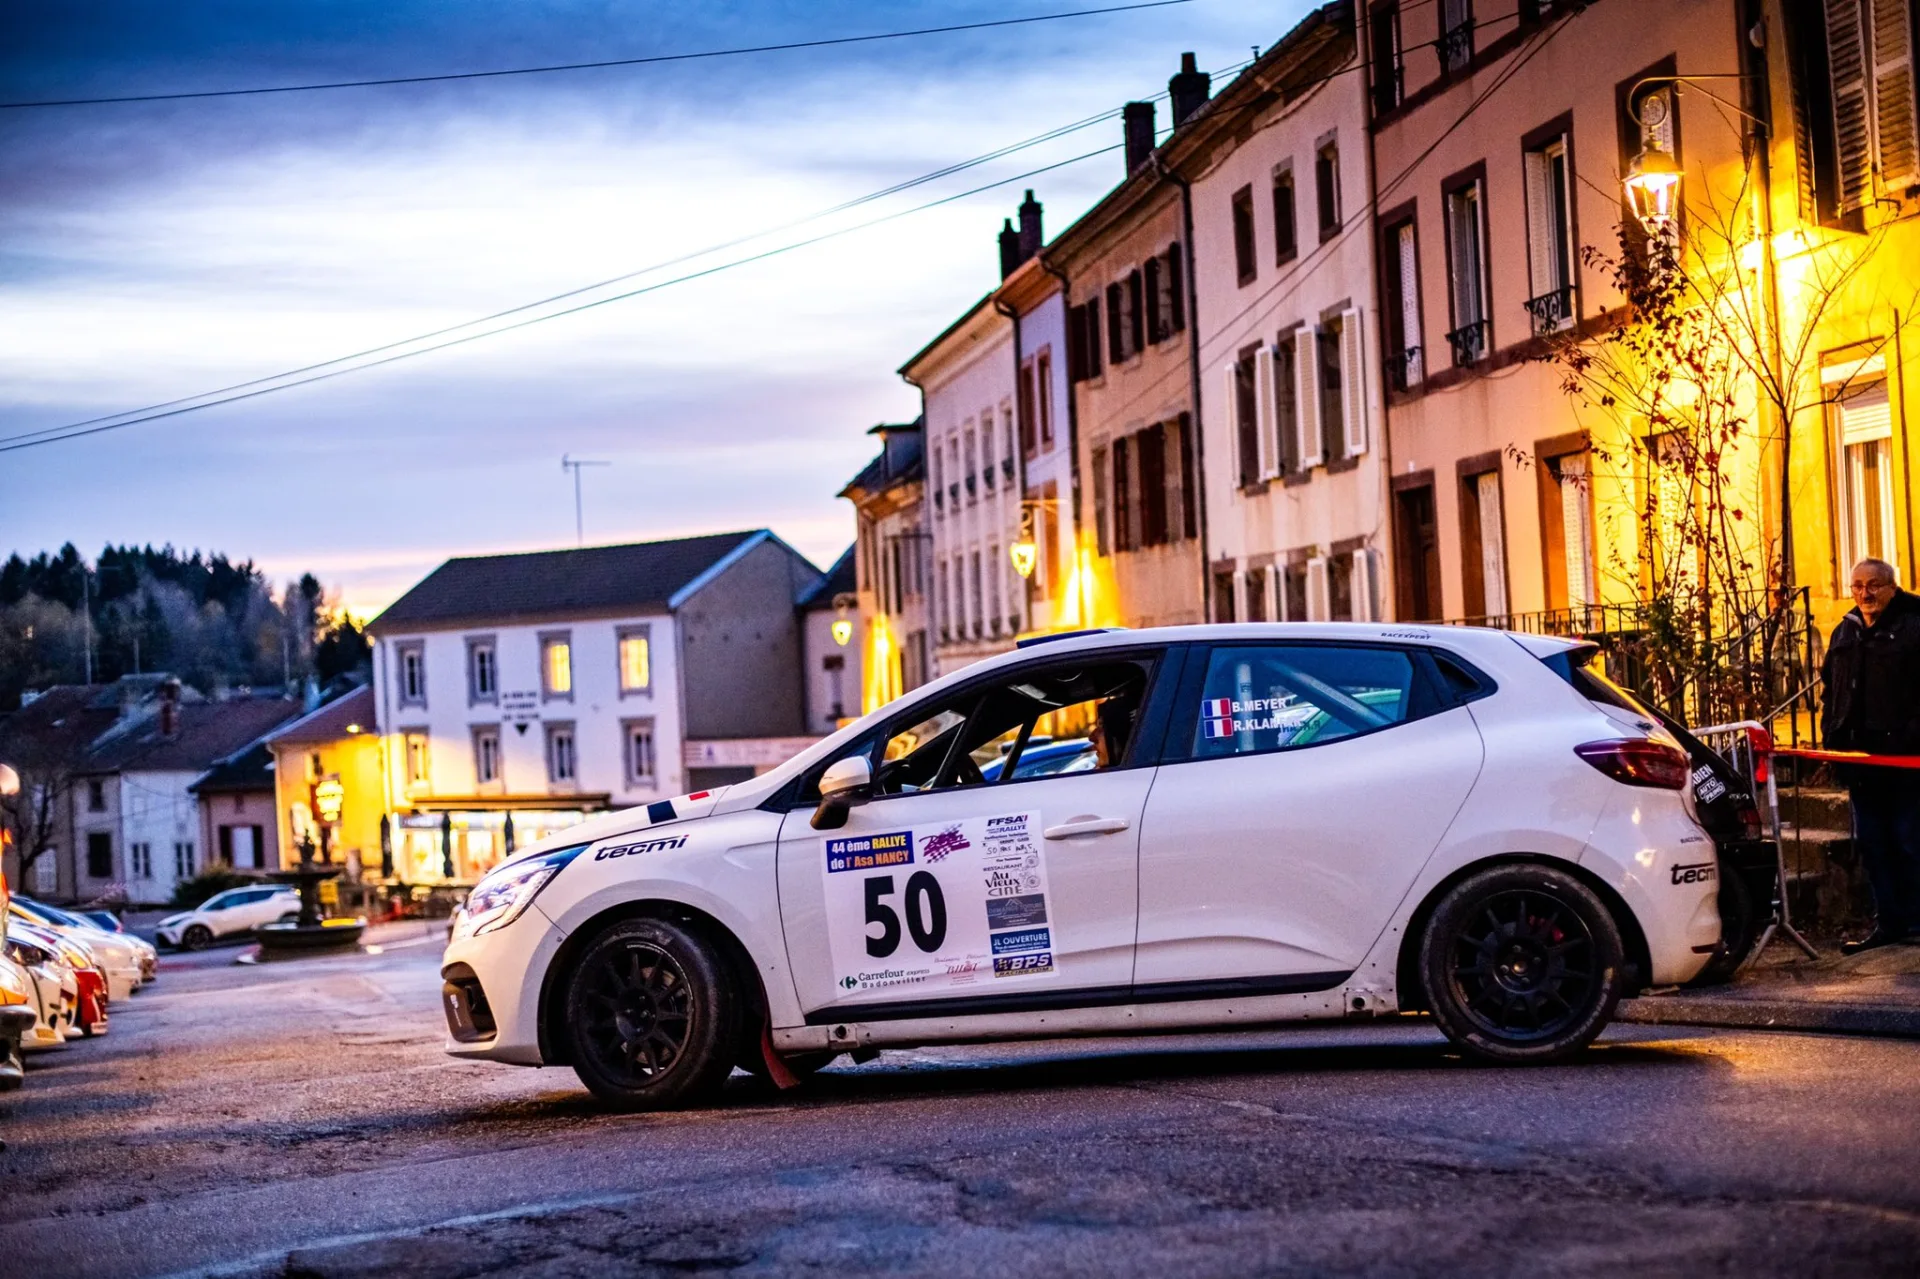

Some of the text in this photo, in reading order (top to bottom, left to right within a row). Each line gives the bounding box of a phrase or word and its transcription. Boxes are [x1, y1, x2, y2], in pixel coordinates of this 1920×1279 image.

[1232, 698, 1287, 713] B.MEYER
[1692, 763, 1714, 786] ABIEN
[1699, 780, 1716, 795] AUTO
[987, 815, 1025, 826] FFSA
[594, 834, 690, 861] tecmi
[832, 835, 907, 853] 44 ème RALLYE
[830, 858, 844, 870] de
[854, 855, 873, 868] Asa
[875, 850, 909, 865] NANCY
[993, 871, 1009, 880] Au
[1671, 862, 1716, 885] tecm
[864, 870, 947, 959] 50
[993, 932, 1048, 946] JL OUVERTURE
[1010, 954, 1050, 970] BPS
[858, 969, 905, 981] Carrefour
[861, 976, 926, 988] Badonviller
